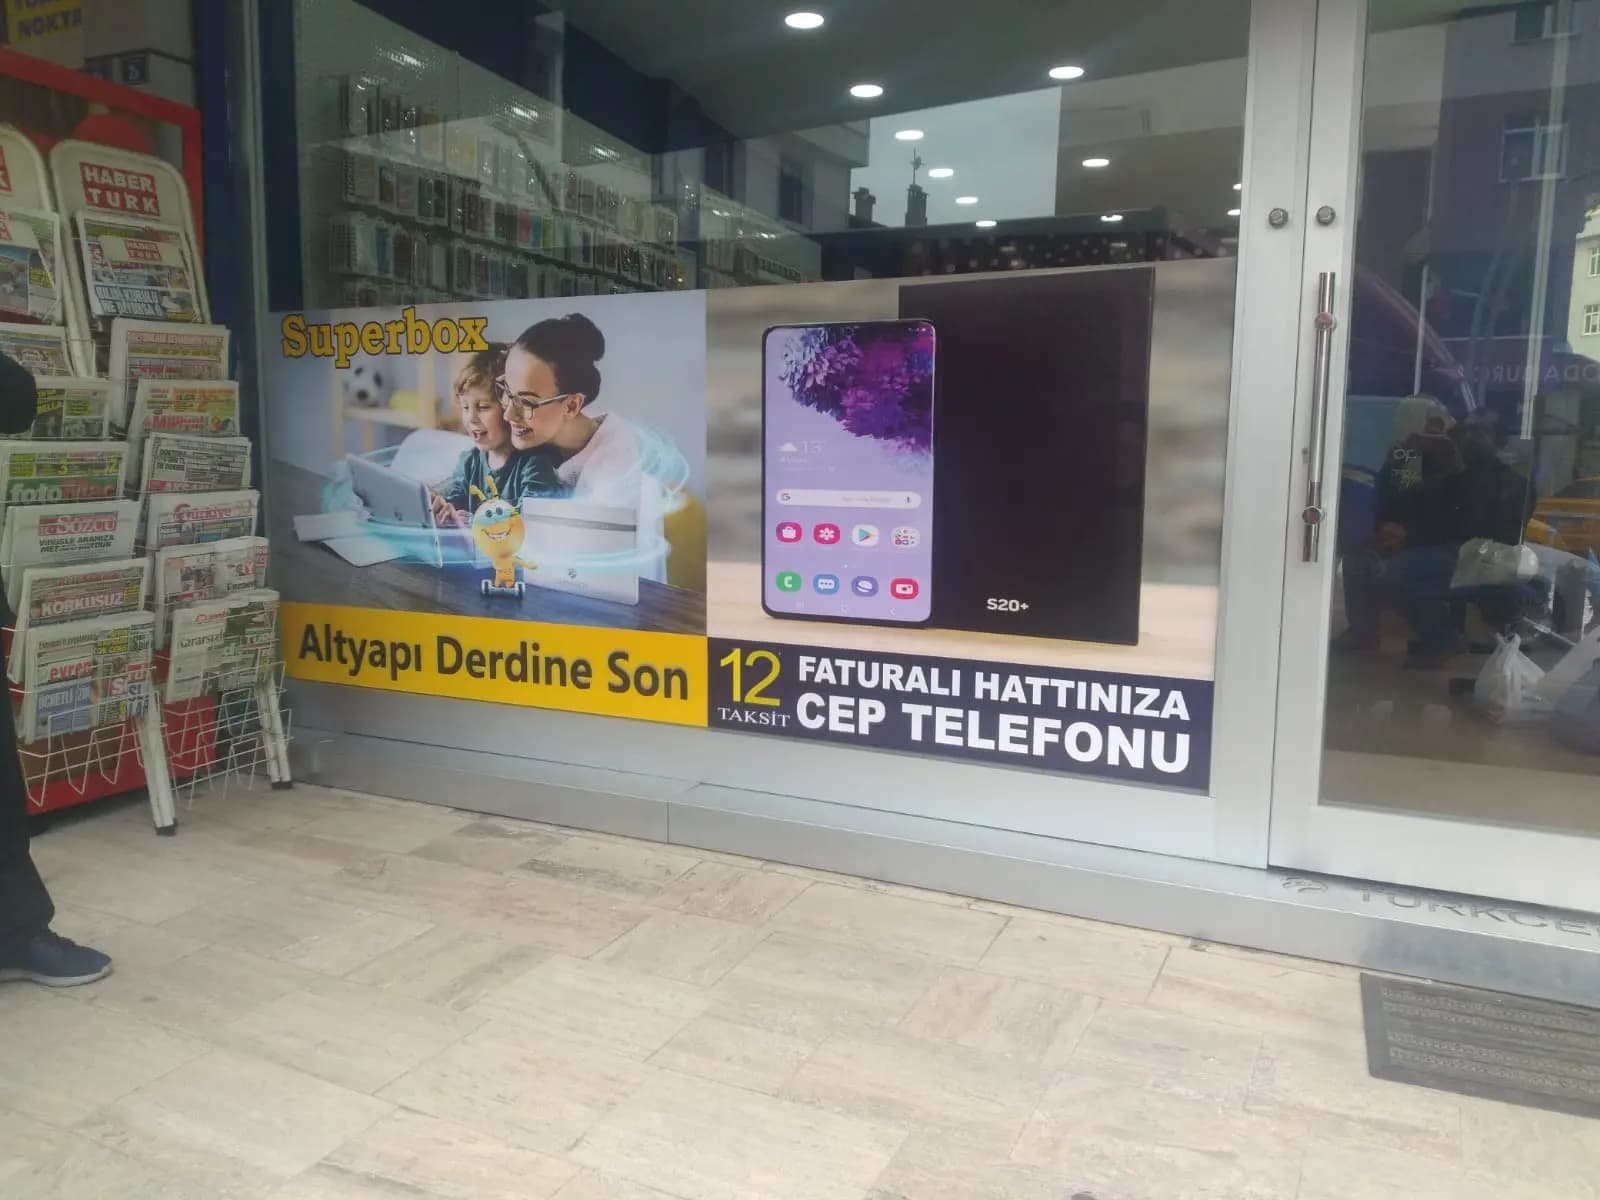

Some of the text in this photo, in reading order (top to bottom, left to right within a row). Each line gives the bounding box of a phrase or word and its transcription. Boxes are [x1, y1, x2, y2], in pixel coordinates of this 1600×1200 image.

[83, 165, 154, 193] HABER
[87, 188, 158, 215] TURK
[281, 305, 489, 369] Superbox
[41, 591, 123, 617] KORKUSUZ
[987, 598, 1029, 612] S20+
[298, 623, 688, 701] Altyapı Derdine Son
[720, 647, 781, 707] 12
[799, 655, 1190, 721] FATURALI HATTINIZA
[717, 707, 790, 728] TAKSİT
[796, 691, 1190, 774] CEP TELEFONU
[1358, 887, 1600, 937] TURKCE
